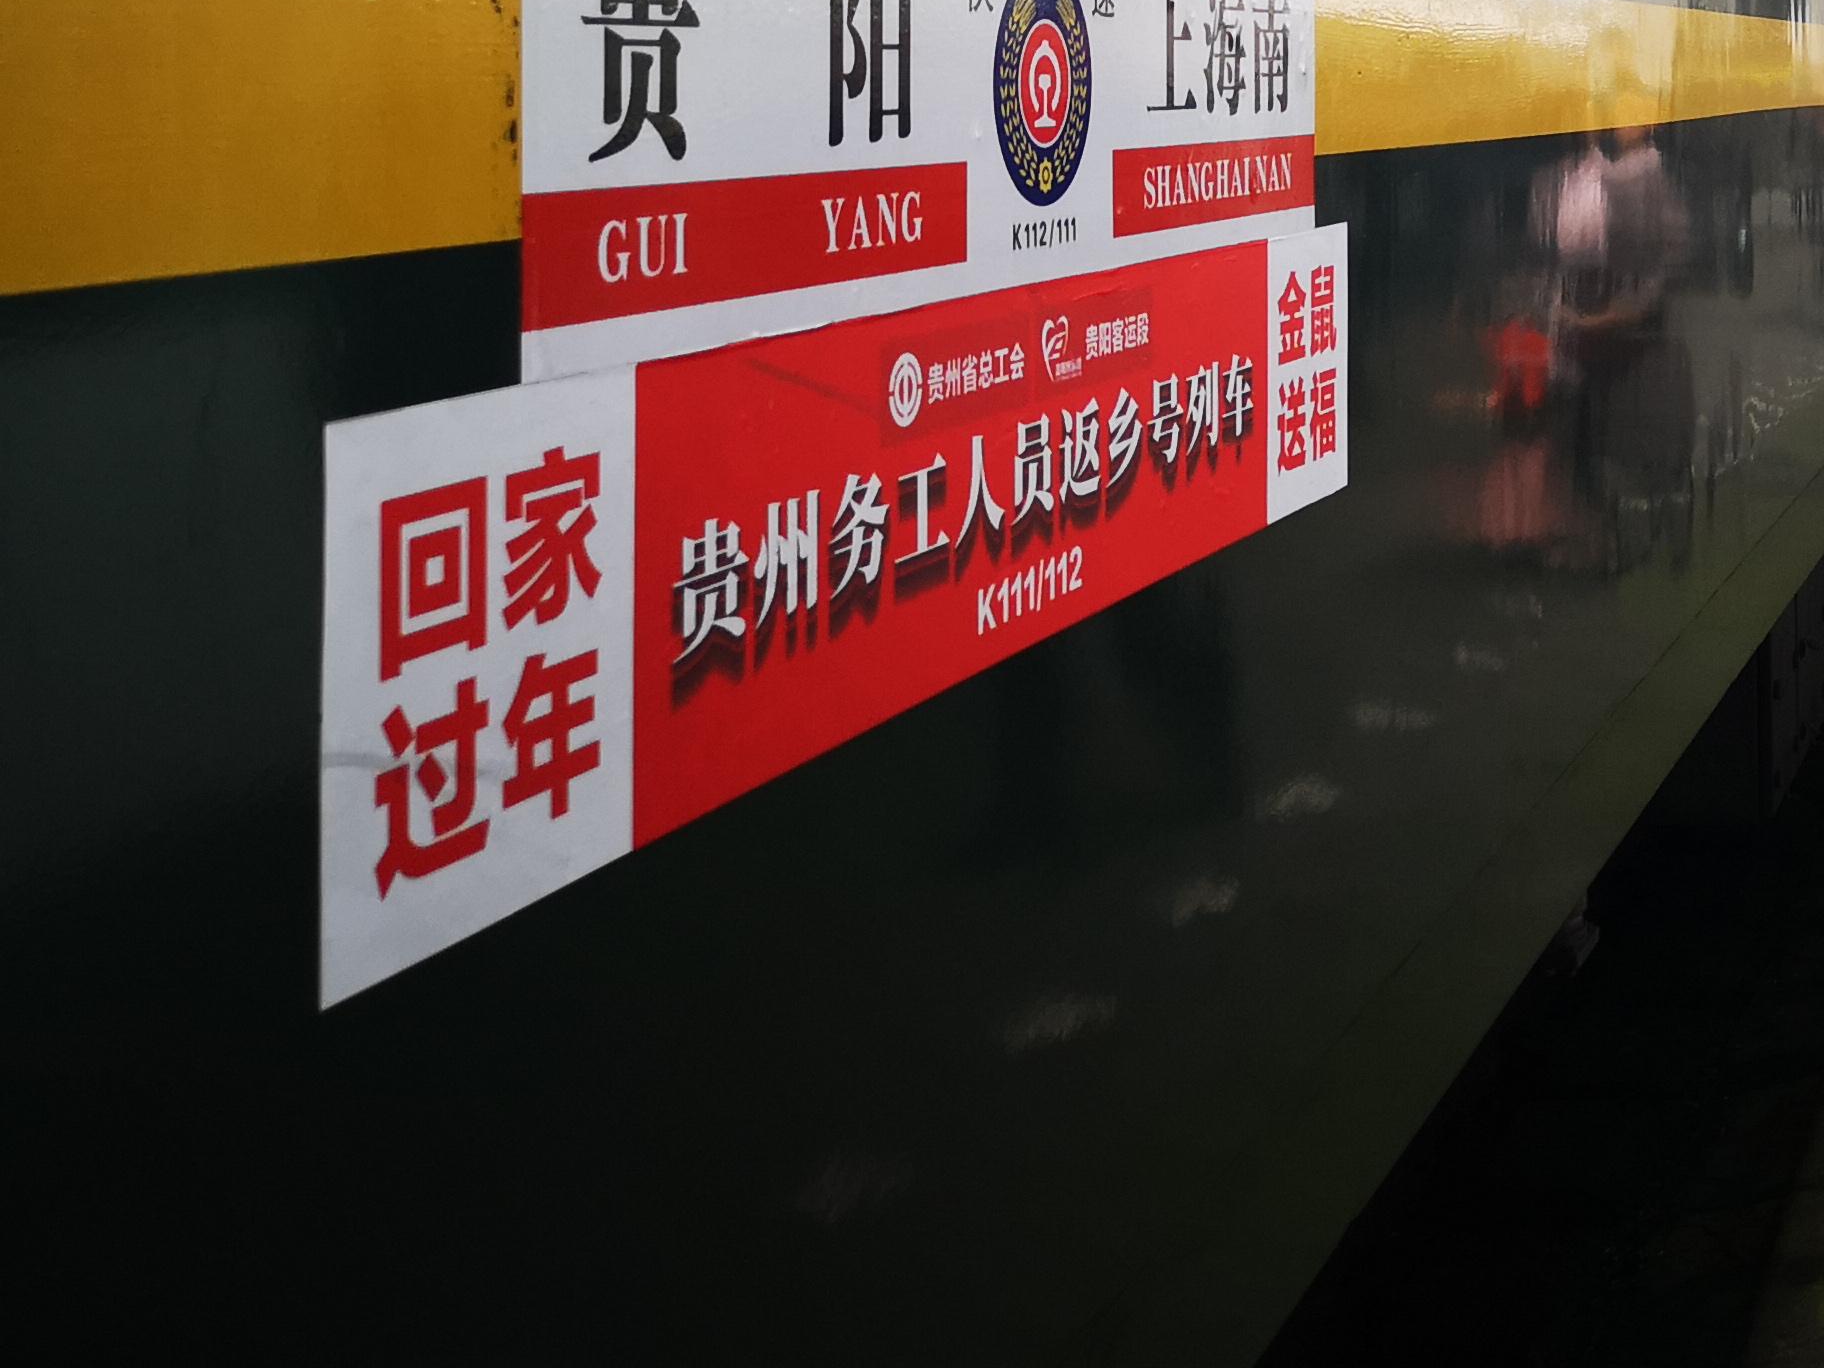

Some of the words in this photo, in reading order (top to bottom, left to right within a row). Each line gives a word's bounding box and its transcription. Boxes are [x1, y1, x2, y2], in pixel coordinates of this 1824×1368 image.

[598, 213, 688, 283] GUI
[821, 191, 923, 254] YANG
[1012, 217, 1077, 250] K112/111
[927, 342, 1025, 404] 贵州省总工会
[1085, 312, 1149, 360] 贵阳客运段
[672, 354, 1254, 666] 贵州务工人员返乡号列车
[977, 546, 1083, 635] K111/112
